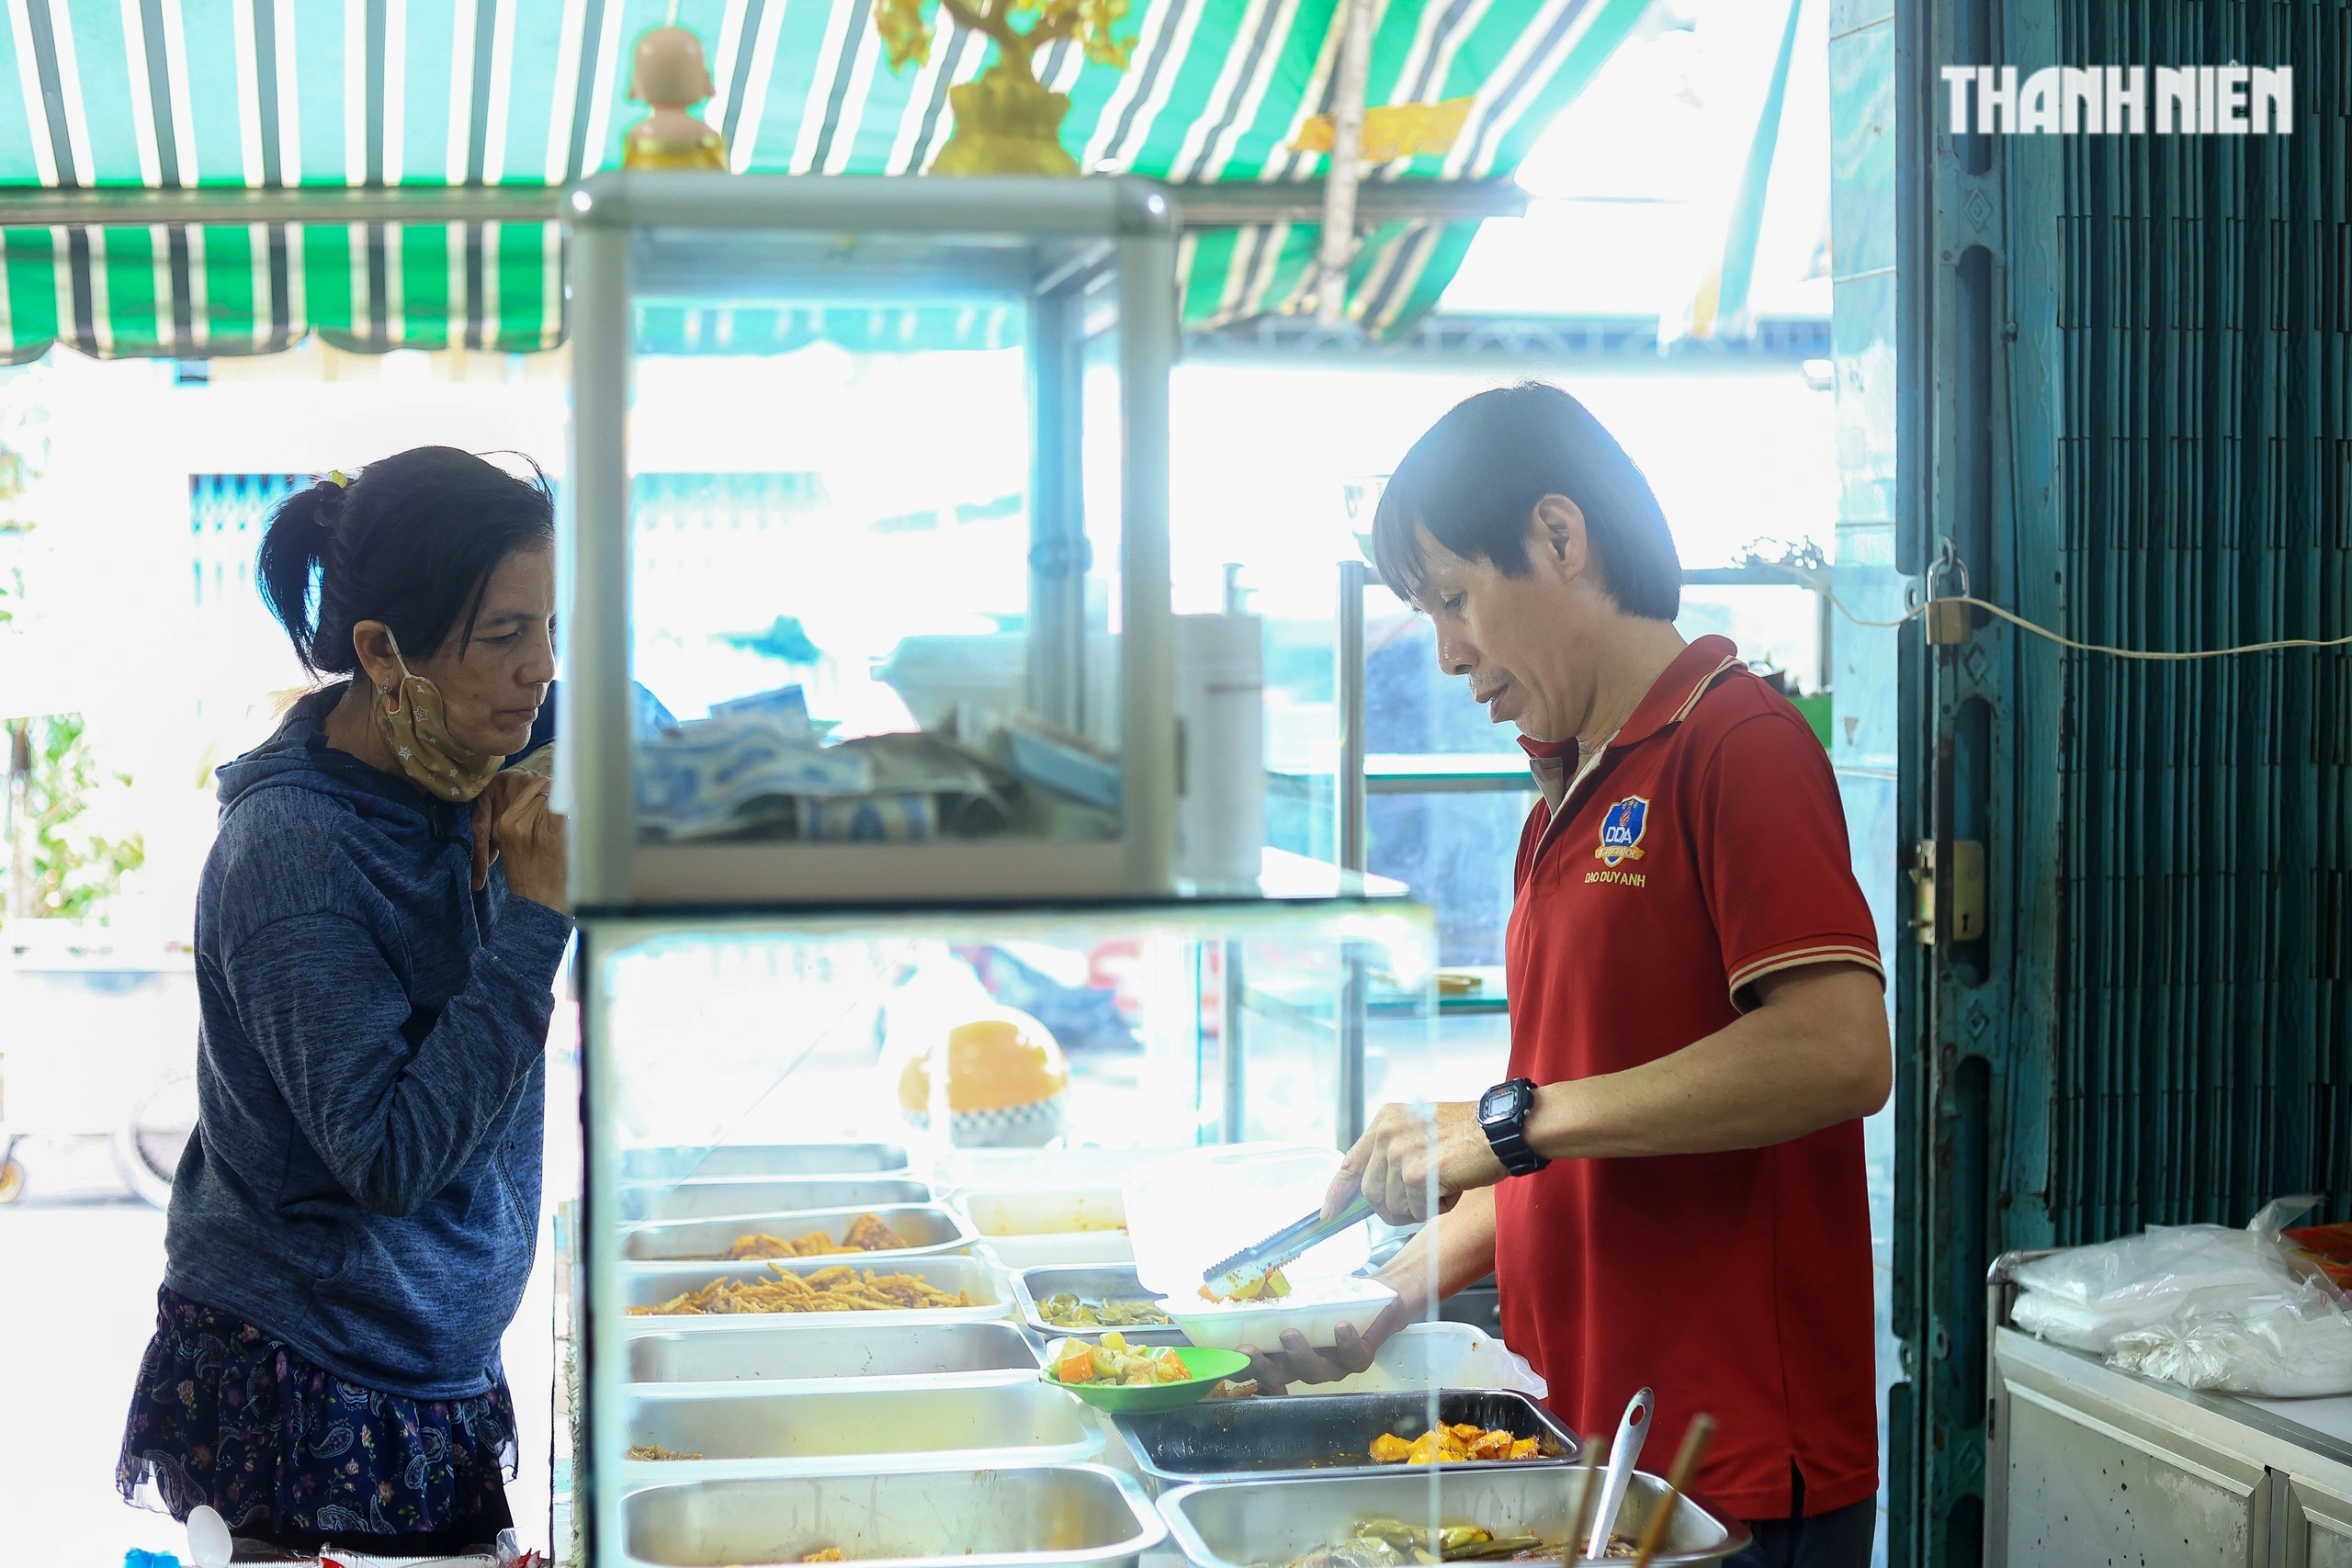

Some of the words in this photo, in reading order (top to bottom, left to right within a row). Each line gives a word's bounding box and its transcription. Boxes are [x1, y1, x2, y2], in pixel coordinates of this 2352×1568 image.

[1605, 827, 1632, 844] DDA
[1600, 871, 1622, 884] DUY
[1620, 873, 1646, 888] ANH
